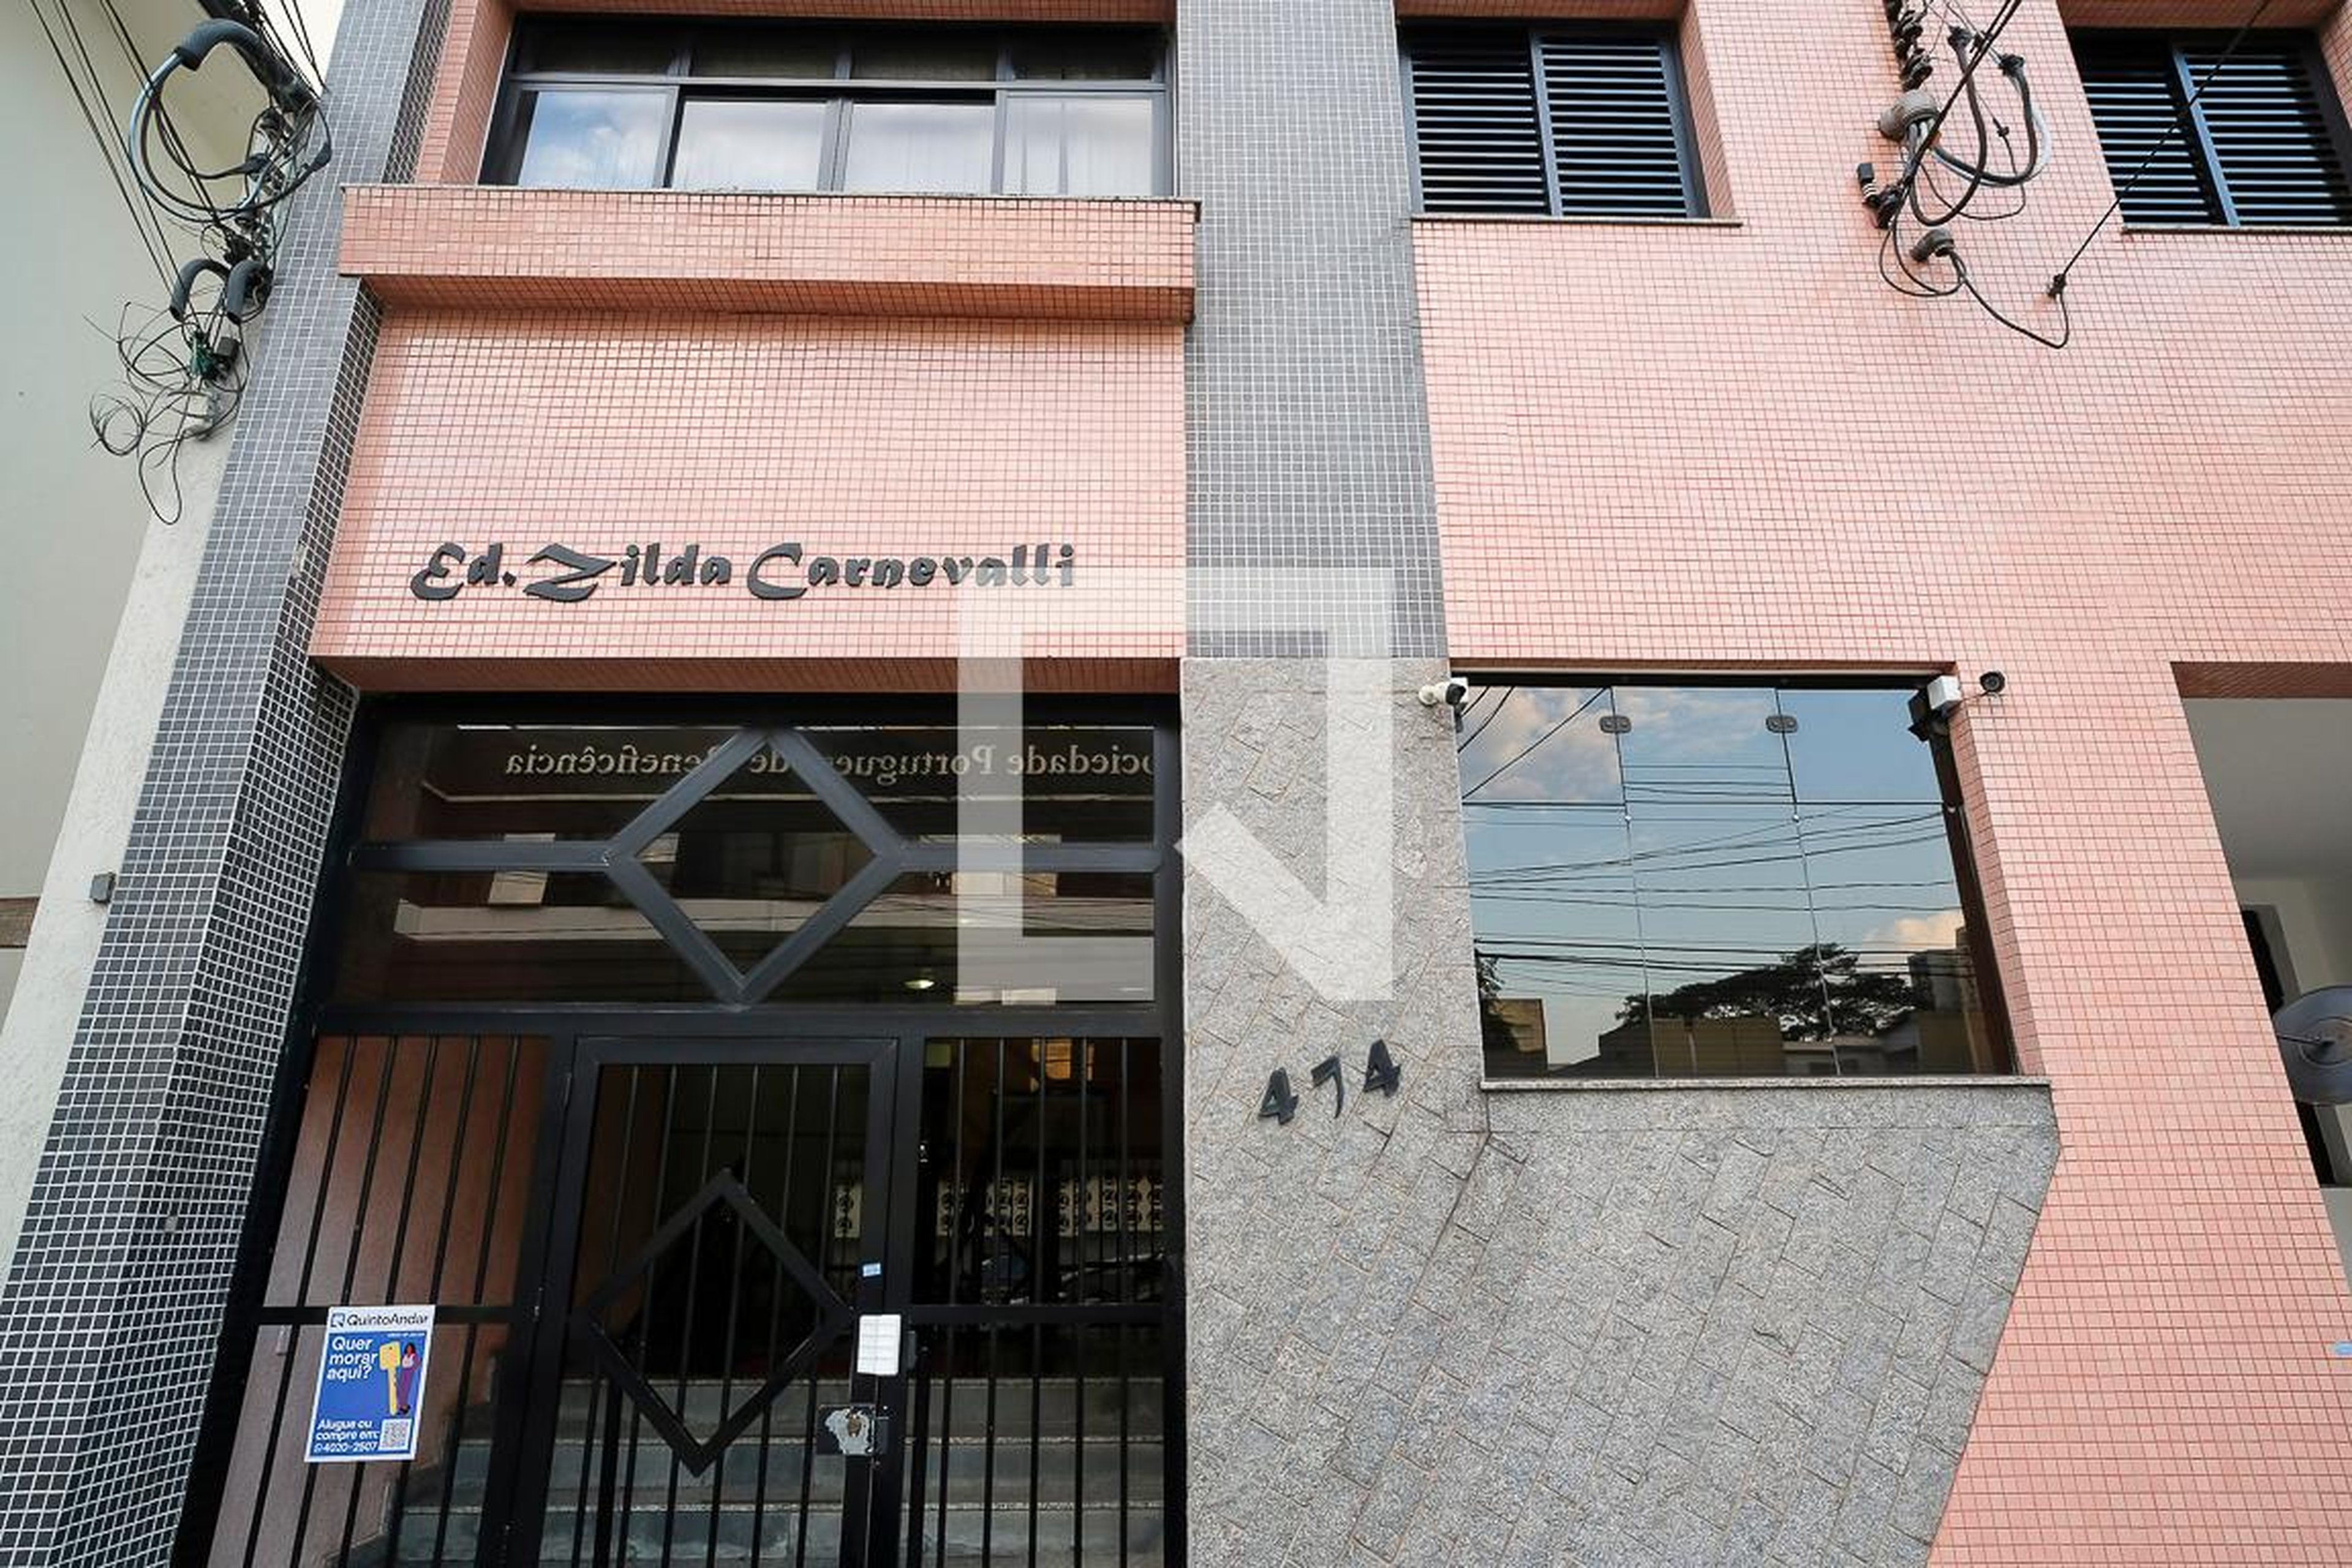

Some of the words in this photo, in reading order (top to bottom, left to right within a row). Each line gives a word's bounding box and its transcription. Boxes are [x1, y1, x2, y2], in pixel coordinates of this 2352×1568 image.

[410, 542, 517, 601] Ed.
[522, 542, 733, 602] Zilda
[747, 543, 1075, 600] Carnevalli
[1257, 1038, 1401, 1125] 474
[346, 1313, 429, 1327] QuintoAndar
[331, 1336, 374, 1351] Quer
[328, 1352, 379, 1366] morar
[326, 1365, 373, 1382] aqui?
[315, 1431, 357, 1442] compre
